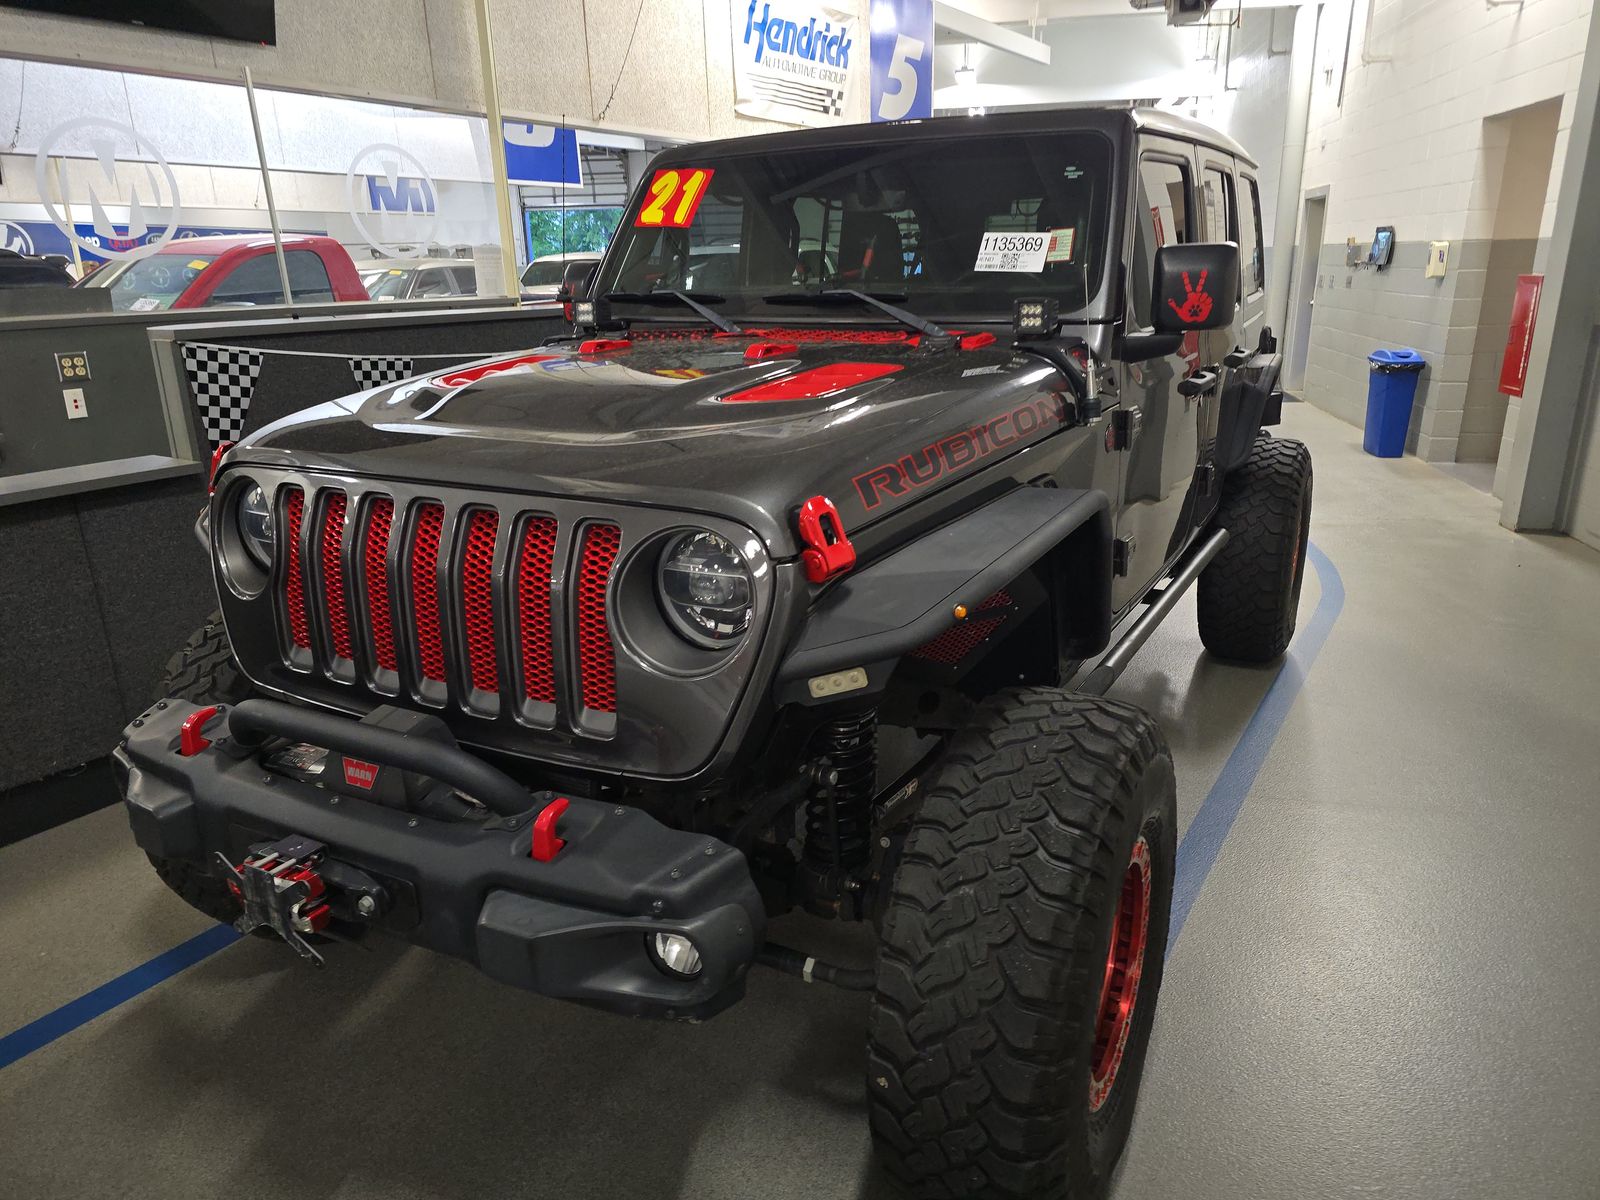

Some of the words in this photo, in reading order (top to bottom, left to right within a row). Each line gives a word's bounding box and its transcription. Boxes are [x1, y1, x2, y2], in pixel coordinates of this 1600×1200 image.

[743, 0, 852, 69] Hendrick
[761, 55, 817, 79] AUTOMOTIVE
[818, 68, 847, 85] GROUP
[878, 33, 925, 120] 5
[641, 171, 706, 224] 21
[984, 236, 1044, 252] 1135369
[852, 392, 1066, 511] RUBICON
[347, 766, 372, 782] WARN
